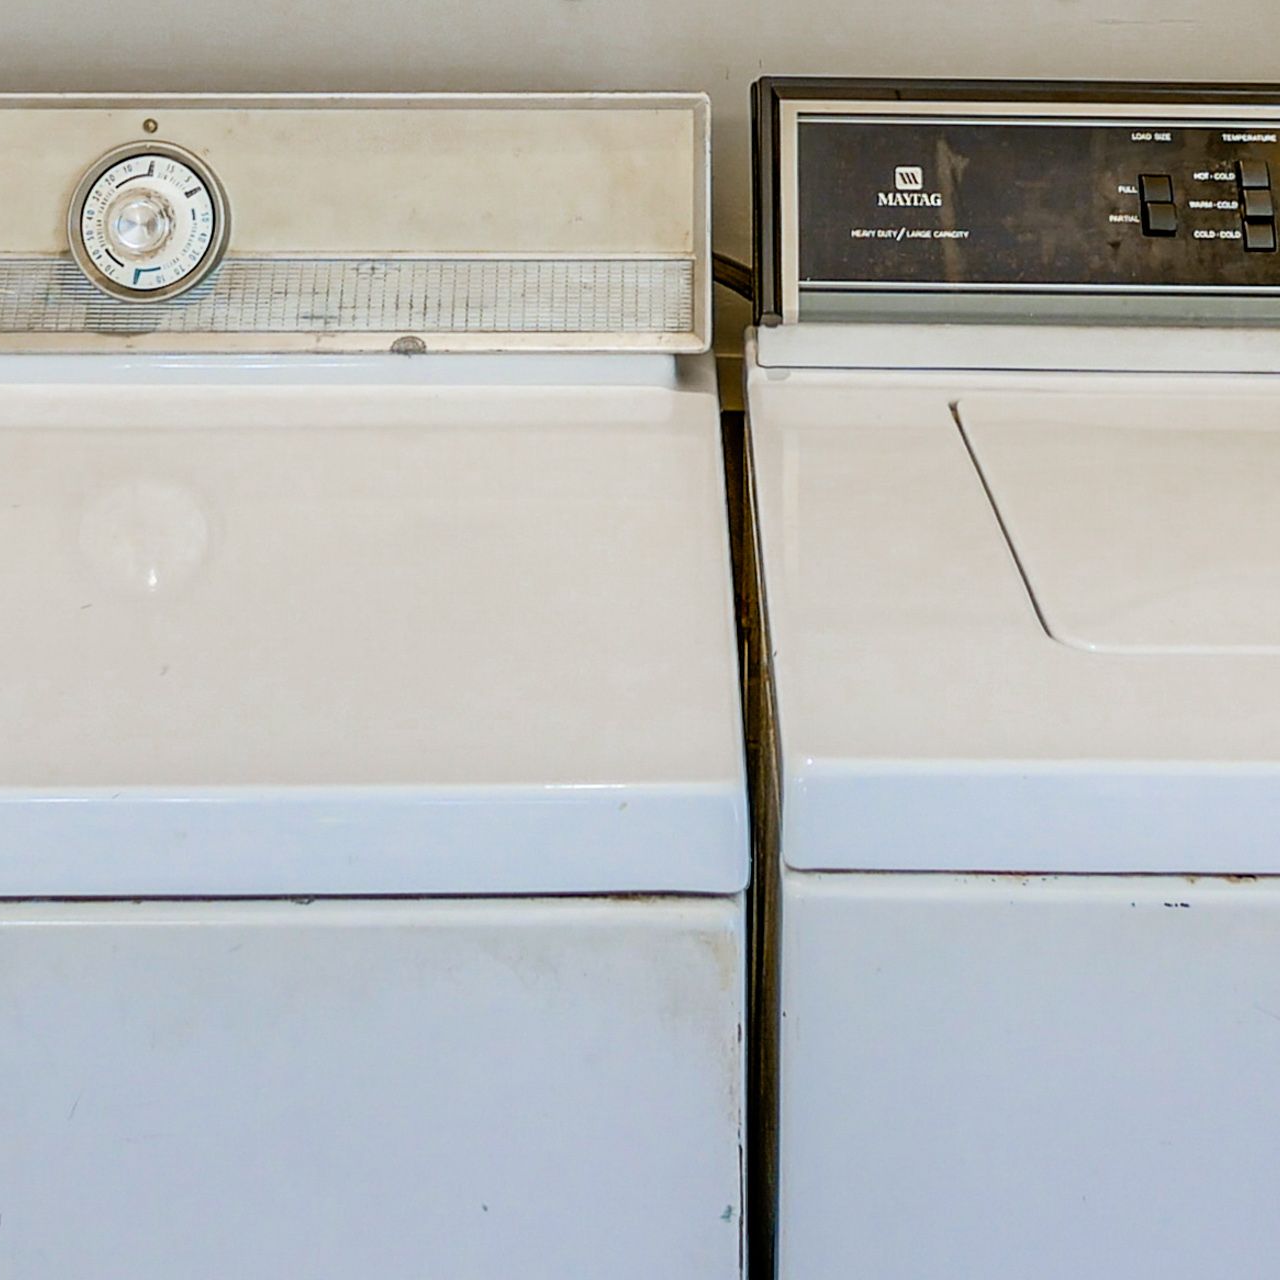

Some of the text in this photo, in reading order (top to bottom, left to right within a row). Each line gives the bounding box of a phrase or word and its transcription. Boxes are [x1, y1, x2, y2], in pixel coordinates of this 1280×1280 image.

[1131, 132, 1172, 142] LOAD SIZE
[1222, 134, 1278, 142] TEMPERATURE
[1118, 186, 1138, 194] FULL
[877, 192, 942, 206] MAYTAG
[1109, 215, 1140, 223] PARTIAL
[850, 229, 876, 238] HEAVY
[933, 230, 970, 239] CAPACITY
